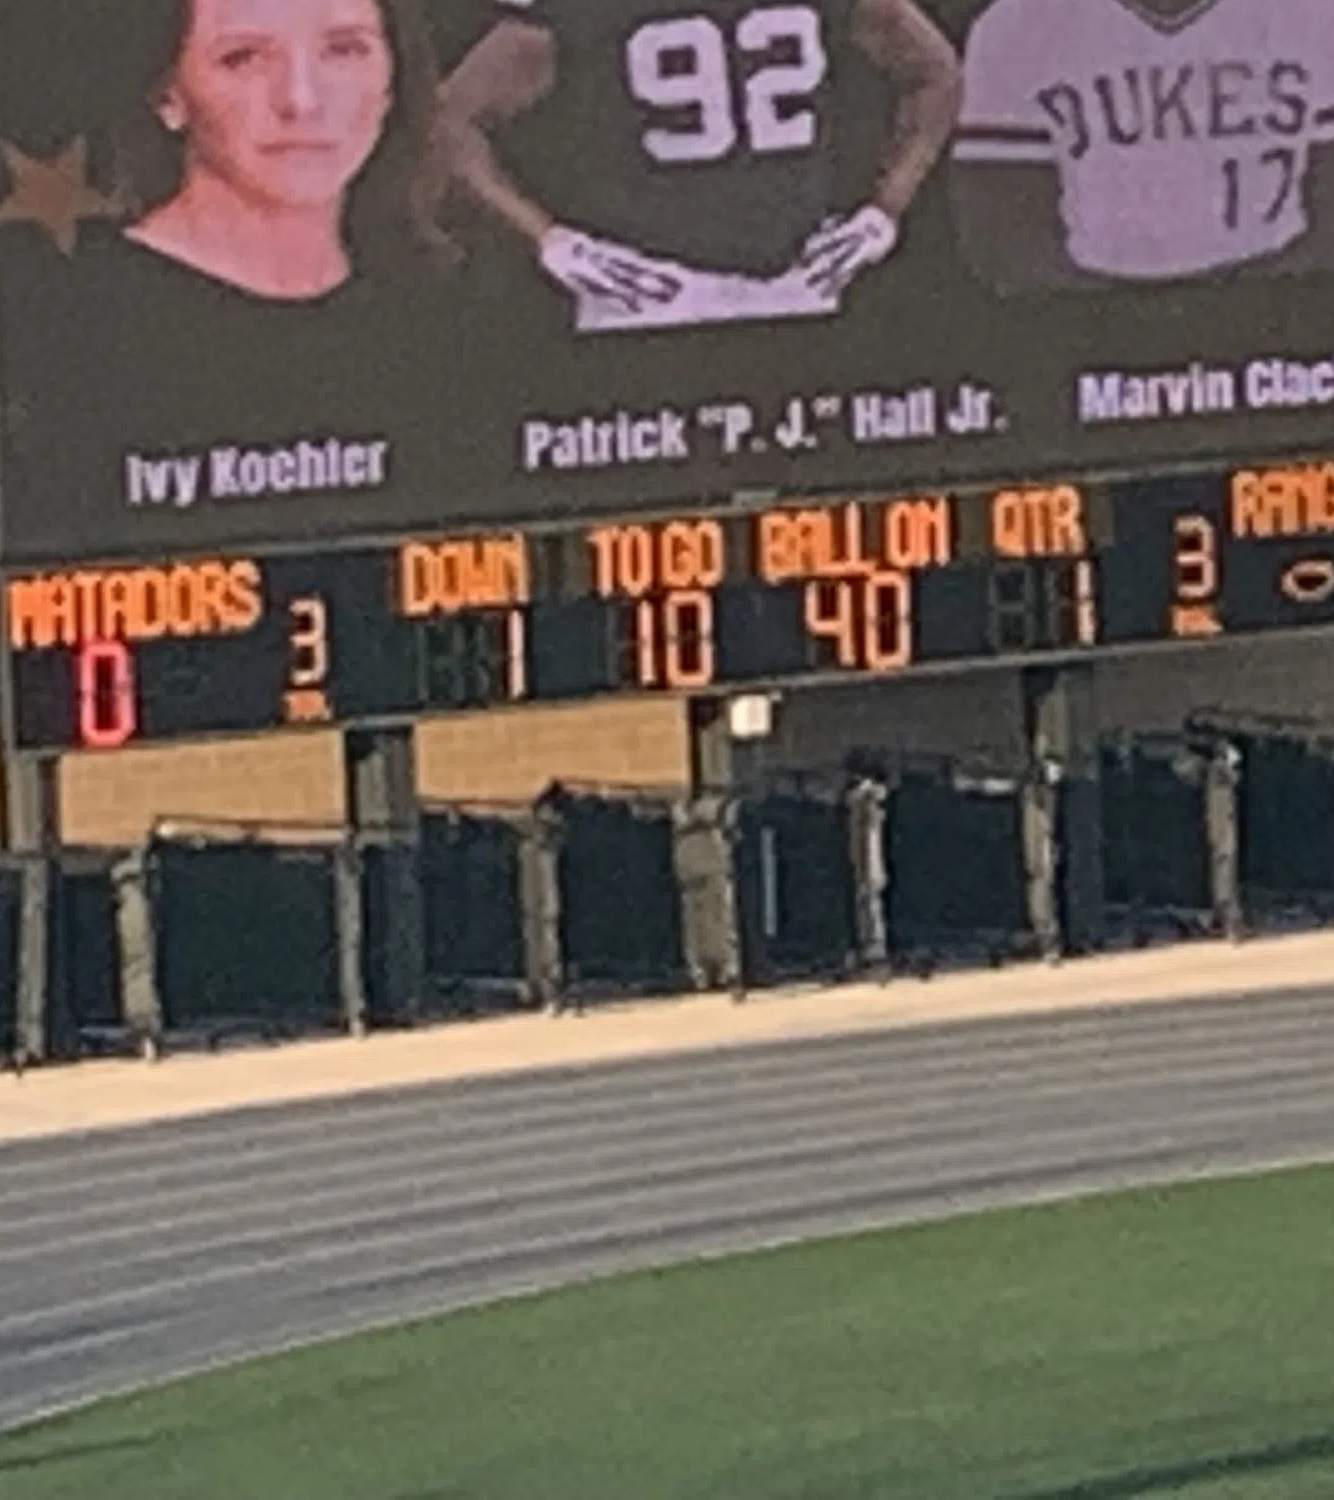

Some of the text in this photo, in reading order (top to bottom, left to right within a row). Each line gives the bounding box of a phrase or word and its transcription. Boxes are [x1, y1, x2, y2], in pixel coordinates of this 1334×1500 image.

[625, 4, 828, 162] 92
[1038, 63, 1312, 159] DUKES
[1219, 152, 1296, 230] 17
[524, 410, 689, 470] Patrick
[851, 388, 936, 442] Hall
[945, 384, 1009, 434] Jr.
[1078, 362, 1234, 422] Marvin
[126, 453, 201, 508] Ivy
[993, 486, 1085, 558] QTR
[402, 534, 528, 613] DOWN
[591, 520, 725, 596] TO GO
[759, 498, 949, 583] BALL ON
[1174, 516, 1215, 598] 3
[8, 560, 261, 647] MATADORS
[289, 599, 327, 685] 3
[635, 593, 714, 688] 10
[805, 572, 912, 670] 40
[1075, 558, 1096, 644] 1
[79, 642, 135, 746] 0
[510, 610, 526, 697] 1
